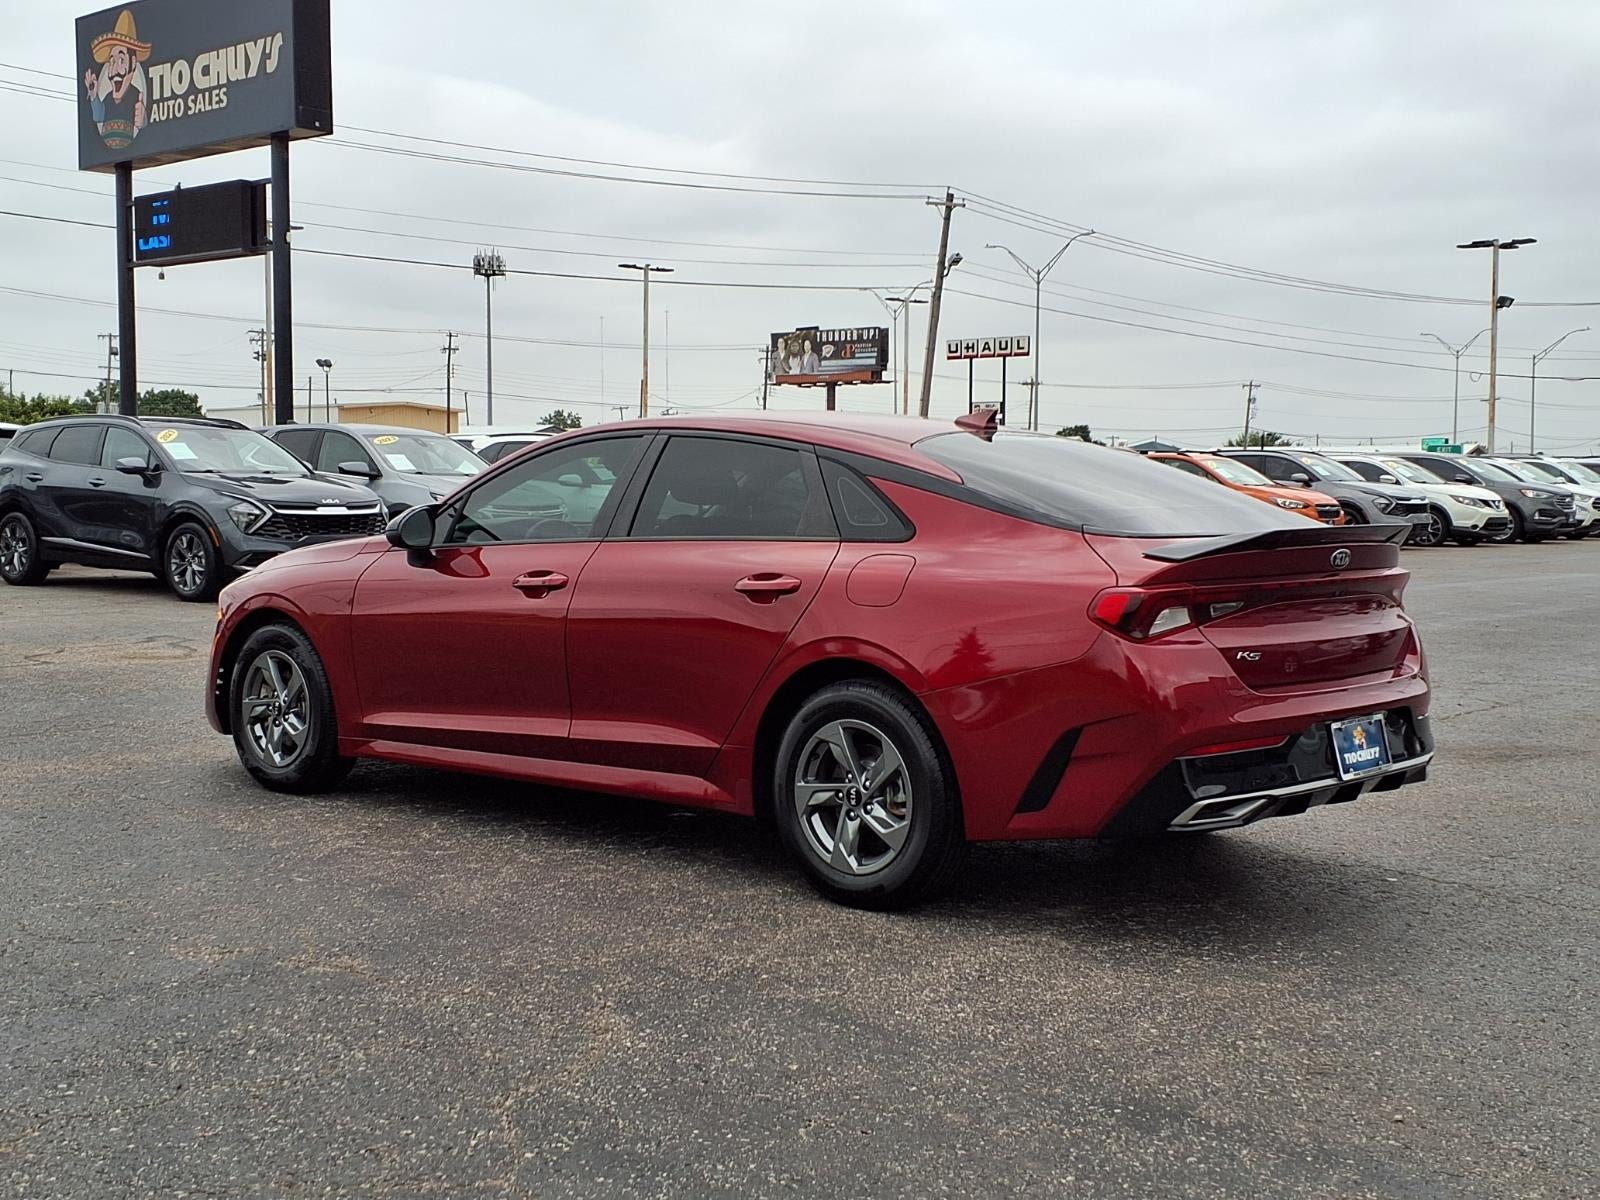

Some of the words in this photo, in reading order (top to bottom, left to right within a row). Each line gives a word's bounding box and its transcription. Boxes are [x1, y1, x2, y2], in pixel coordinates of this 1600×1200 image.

[149, 60, 191, 100] TIO
[193, 32, 283, 89] CHUY'S
[150, 100, 184, 123] AUTO
[188, 88, 228, 115] SALES
[816, 330, 858, 342] THUNDER
[862, 328, 879, 340] UP!
[1236, 651, 1262, 661] K5
[1343, 751, 1357, 765] TIO
